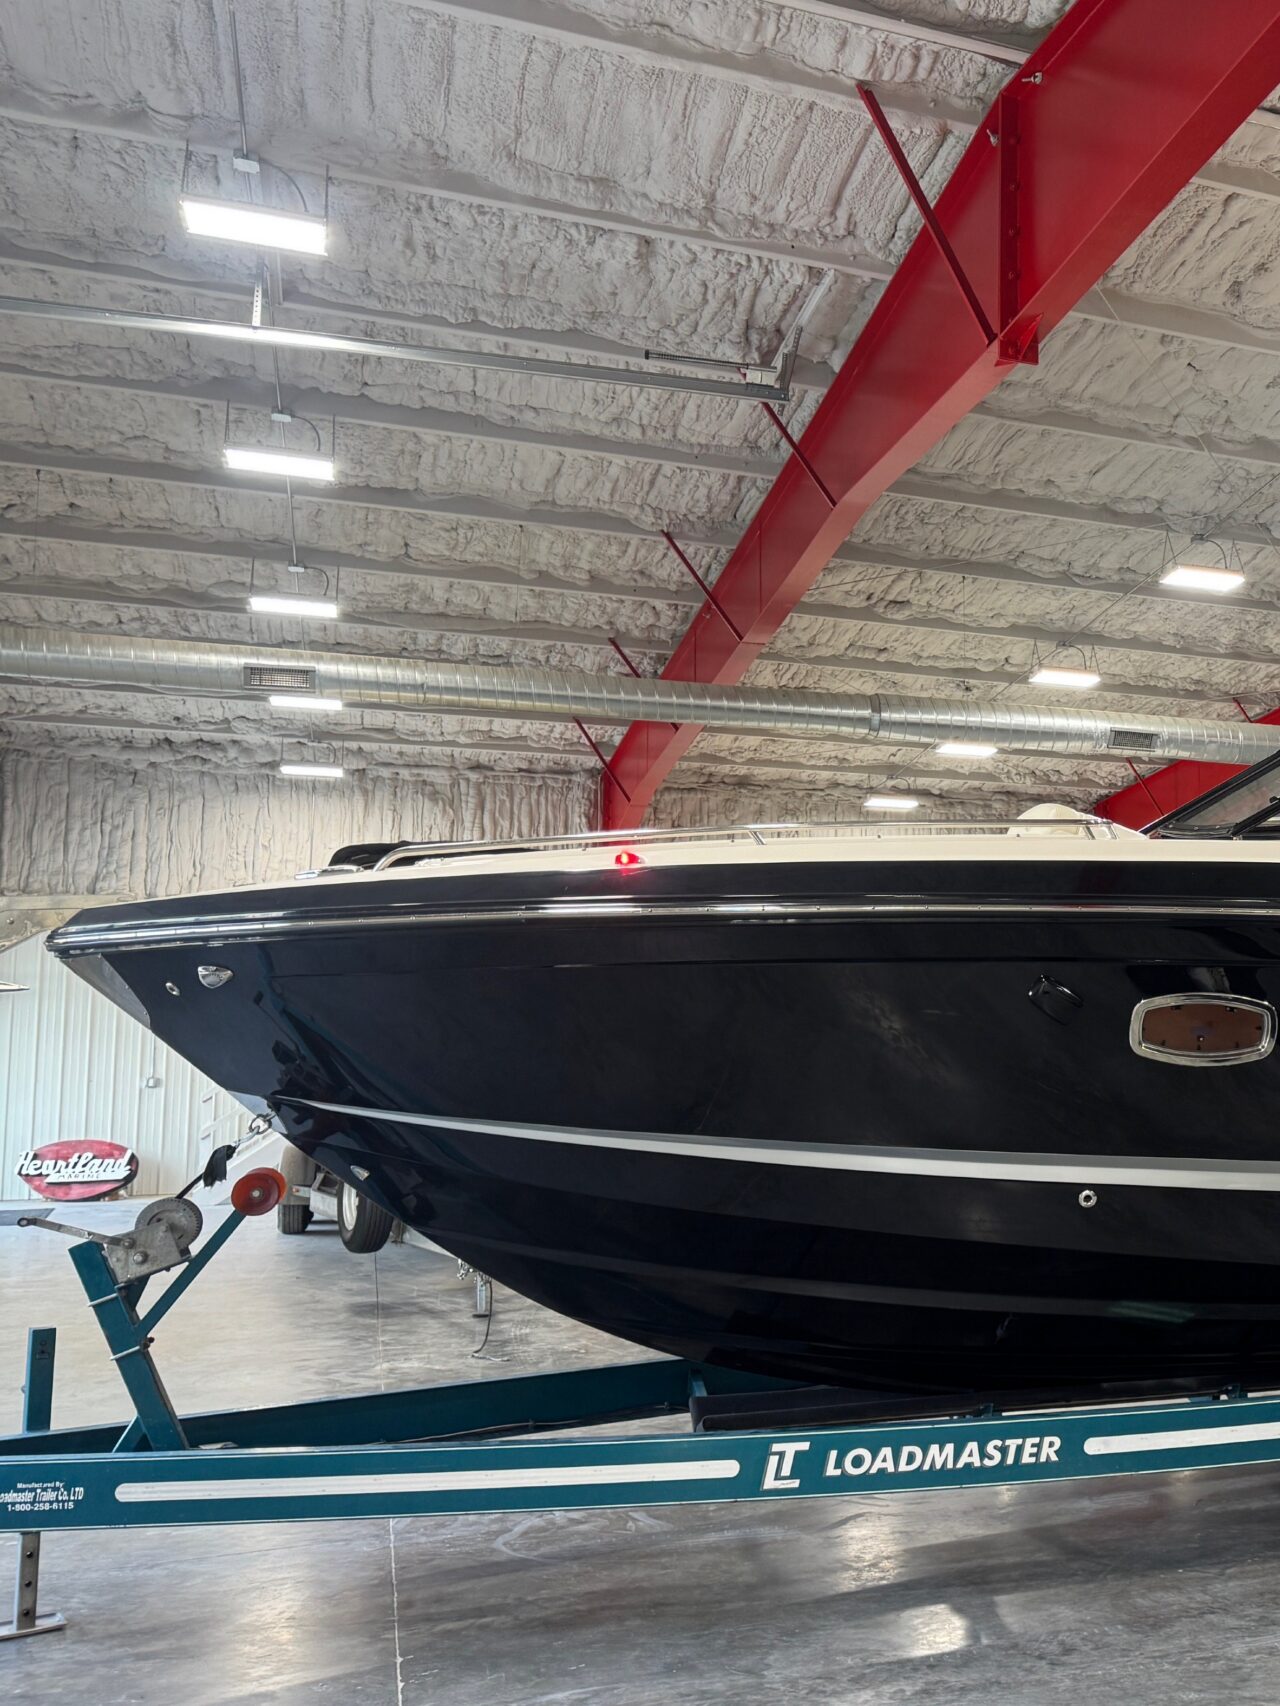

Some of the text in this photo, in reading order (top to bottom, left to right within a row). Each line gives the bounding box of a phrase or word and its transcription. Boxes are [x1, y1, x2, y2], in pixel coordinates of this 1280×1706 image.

[16, 1149, 132, 1176] Heartland
[57, 1172, 101, 1180] MARINE
[824, 1436, 1061, 1477] LOADMASTER
[0, 1490, 35, 1503] oadmaster
[36, 1489, 58, 1501] Trailer
[70, 1487, 84, 1500] LTD
[7, 1502, 74, 1511] 1-800-258-6115
